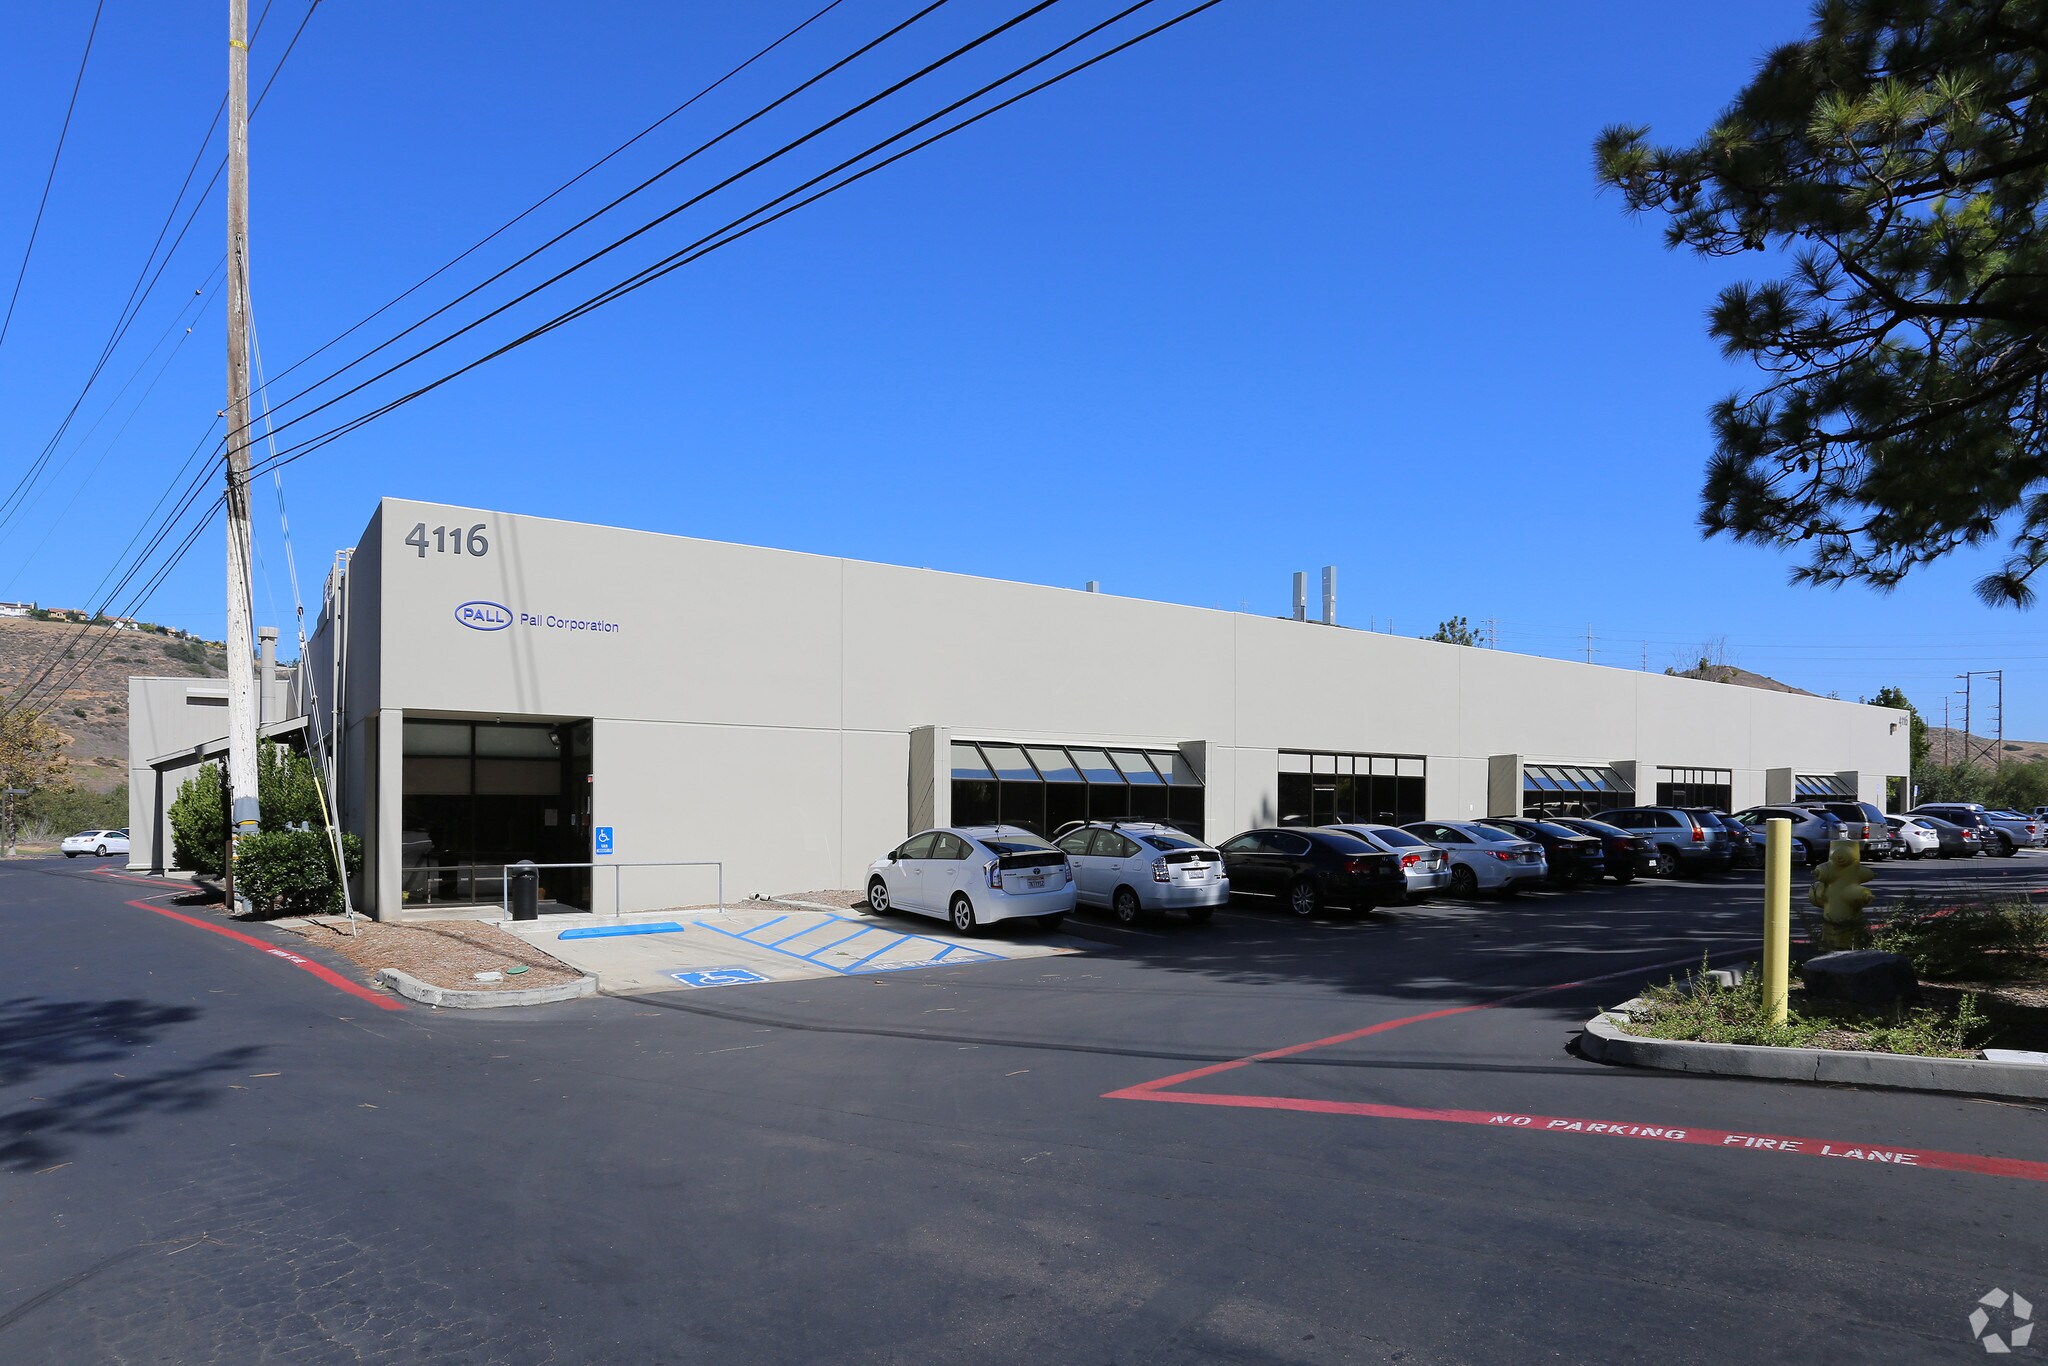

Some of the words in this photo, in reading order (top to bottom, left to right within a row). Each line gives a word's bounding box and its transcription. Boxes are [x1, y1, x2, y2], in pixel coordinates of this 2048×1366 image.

[404, 522, 490, 558] 4116
[463, 607, 505, 624] PALL
[520, 613, 543, 627] Pall
[546, 615, 619, 634] Corporation
[1488, 1115, 1532, 1126] NO
[1546, 1119, 1687, 1140] PARKING
[1723, 1134, 1804, 1152] FIRE
[1820, 1145, 1920, 1166] LANE
